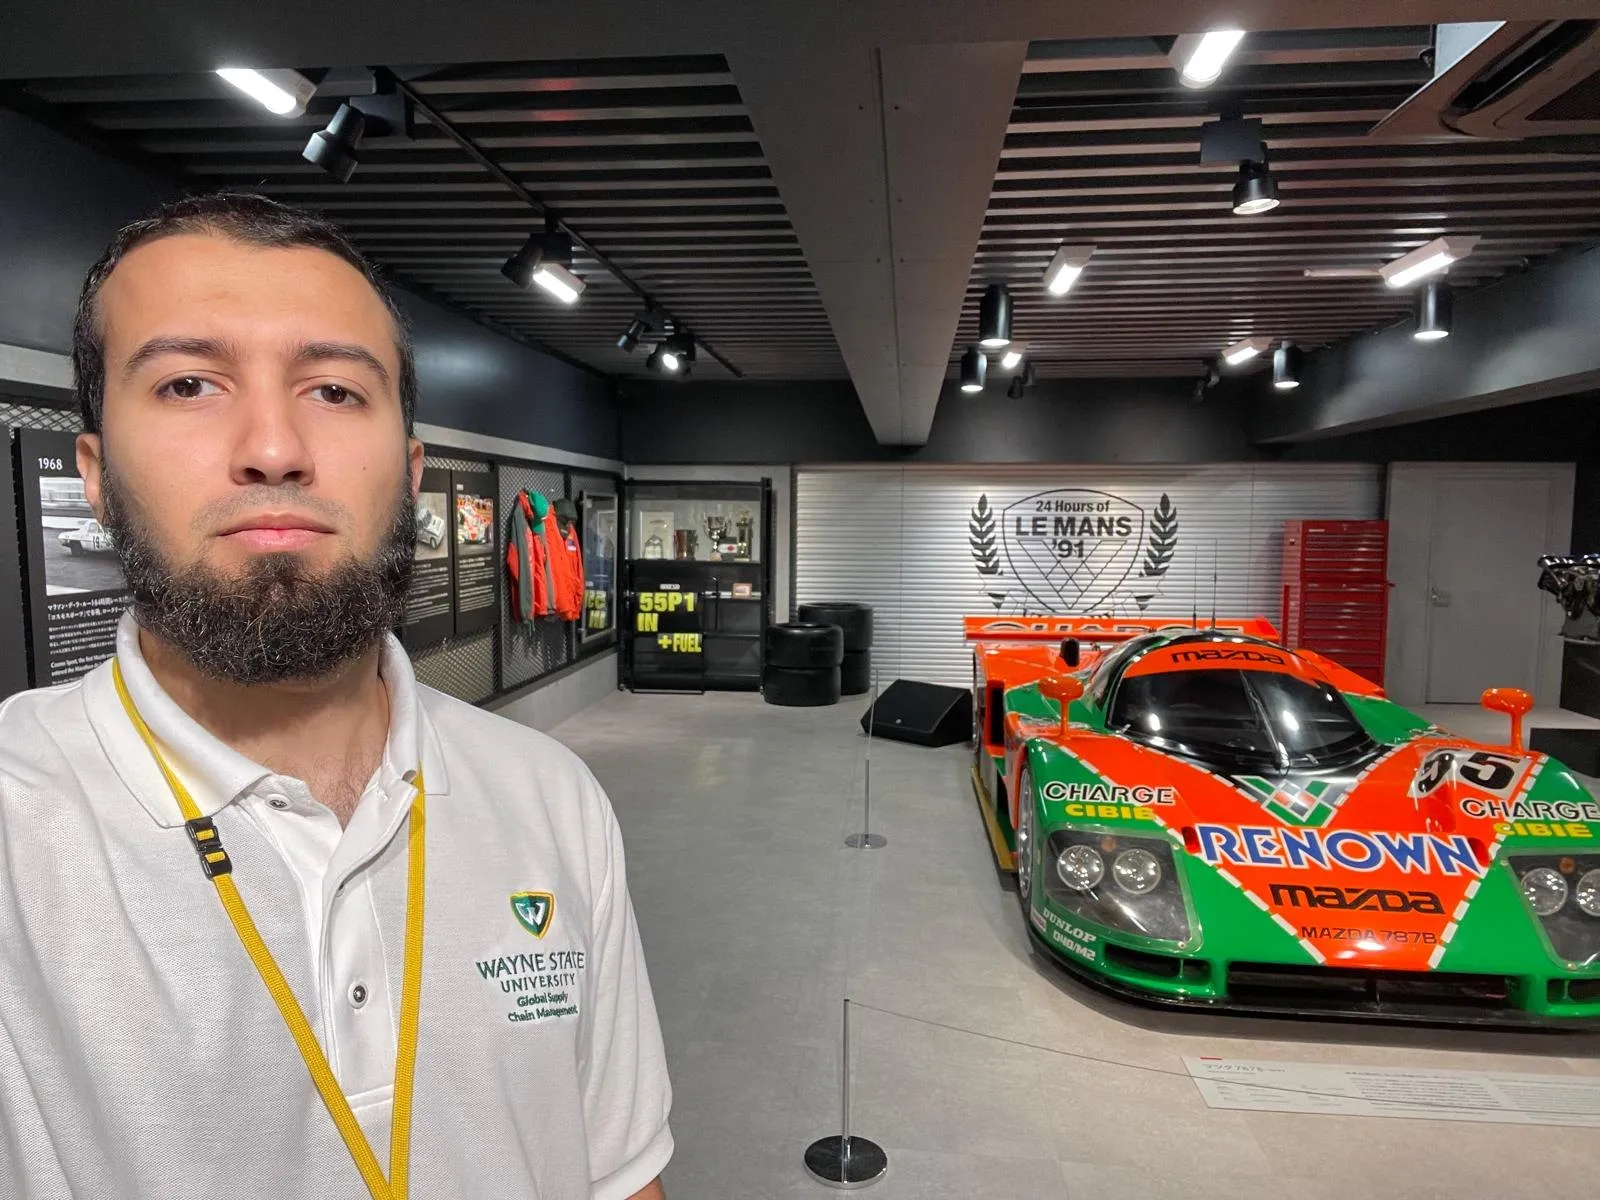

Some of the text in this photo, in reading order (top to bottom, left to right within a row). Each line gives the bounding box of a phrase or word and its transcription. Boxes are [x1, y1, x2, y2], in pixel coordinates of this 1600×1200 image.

[38, 457, 63, 471] 1968
[1035, 499, 1111, 513] 24 Hours of
[1015, 516, 1132, 537] LE MANS
[1052, 539, 1085, 558] '91
[639, 592, 695, 612] 55P1
[637, 613, 659, 632] IN
[1171, 649, 1286, 665] mazda
[1045, 782, 1175, 805] CHARGE
[1065, 803, 1157, 820] CIBIE
[1461, 798, 1600, 821] CHARGE
[1494, 822, 1593, 838] CIBIE
[1196, 825, 1485, 877] RENOWN
[1269, 883, 1446, 915] mazda
[1043, 907, 1097, 942] DUNLOP
[1301, 926, 1438, 944] MAZDA 787B
[476, 951, 585, 979] WAYNE STATE
[501, 973, 575, 993] UNIVERSITY
[517, 991, 568, 1007] Global Supply
[508, 1005, 578, 1022] Chain Management
